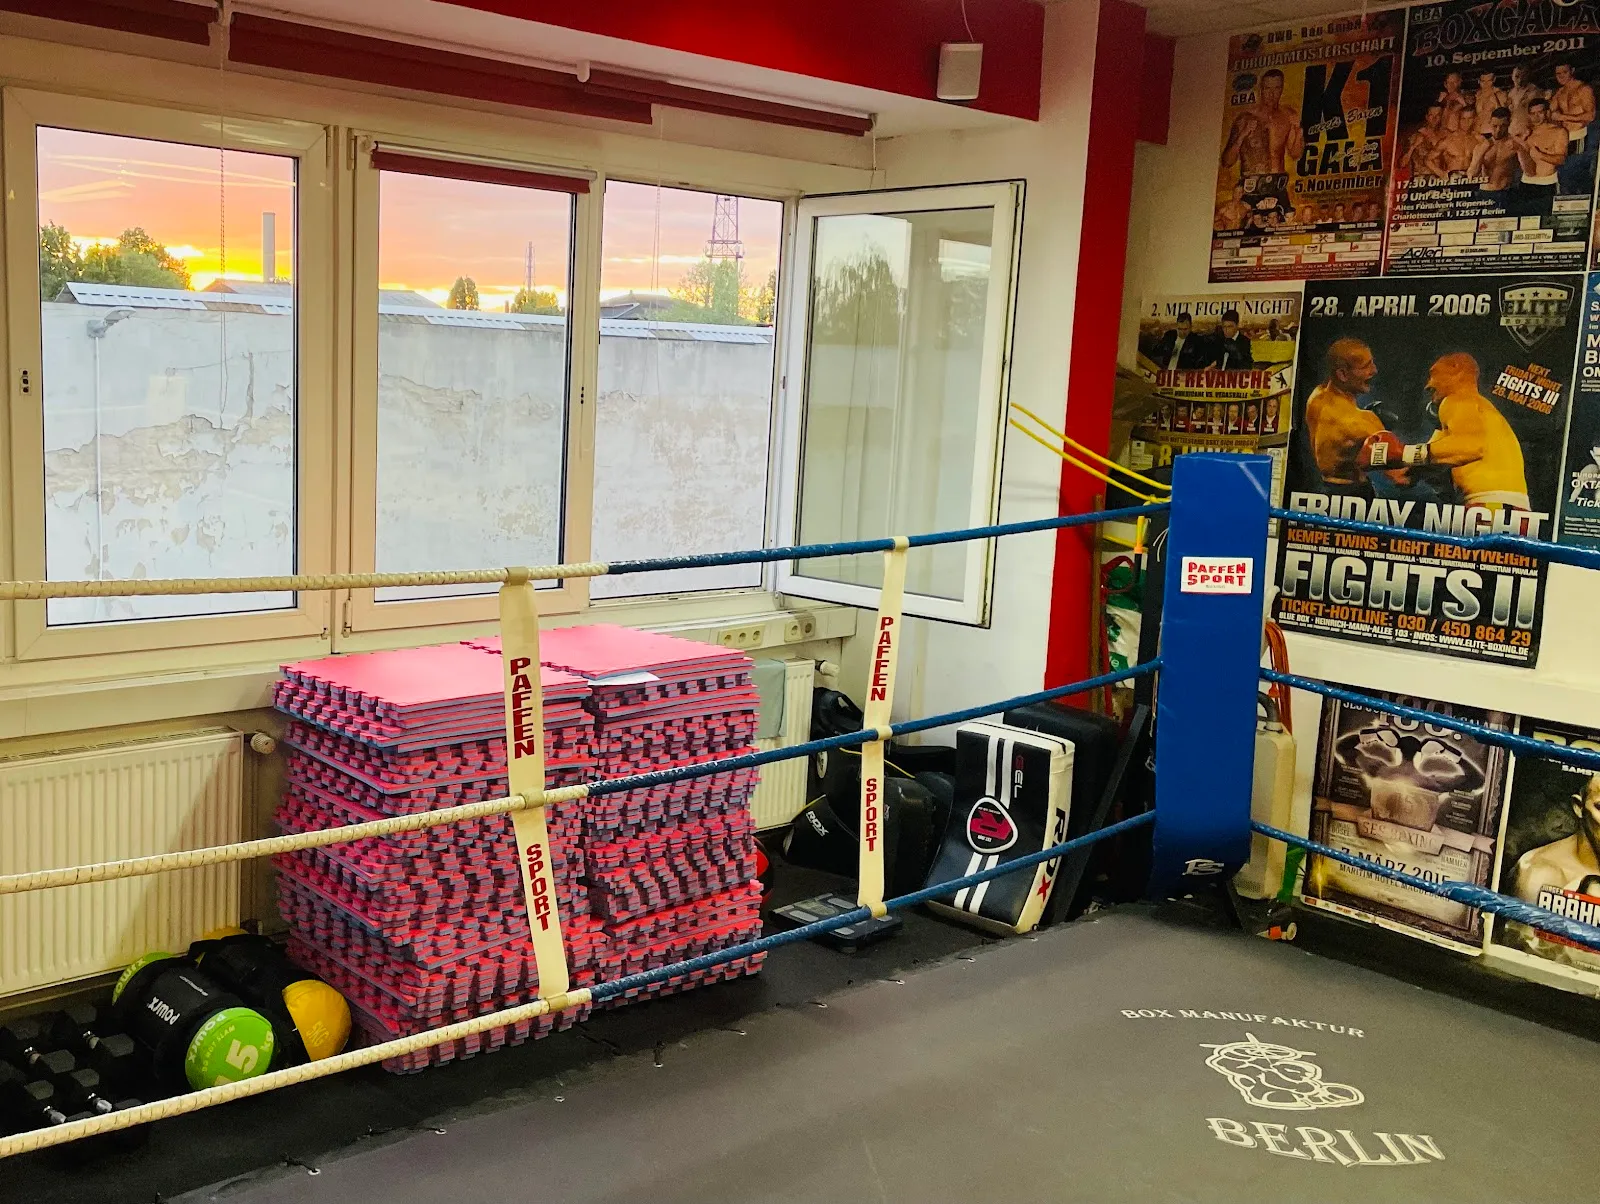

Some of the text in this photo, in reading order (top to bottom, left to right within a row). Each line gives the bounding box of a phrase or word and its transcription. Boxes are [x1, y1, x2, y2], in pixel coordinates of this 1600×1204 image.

[1425, 37, 1586, 68] 10. September 2011
[1301, 54, 1395, 141] K1
[1296, 138, 1384, 177] GALA
[1395, 193, 1409, 203] 19
[1431, 190, 1472, 201] Beginn
[1397, 178, 1427, 189] 17:30
[1427, 176, 1448, 187] Uhr
[1482, 207, 1506, 216] Berlin
[1151, 298, 1295, 317] 2. MIT FIGHT NIGHT
[1309, 293, 1492, 318] 28. APRIL 2006
[1155, 369, 1273, 390] DIE REVANCHE
[1503, 363, 1535, 382] FRIDAY
[1536, 372, 1563, 394] NIGHT
[1527, 361, 1552, 376] NEXT
[1496, 371, 1561, 407] FIGHTS III
[1506, 389, 1527, 406] MAI
[1526, 398, 1554, 416] 2006
[1288, 491, 1416, 528] FRIDAY
[1423, 502, 1549, 541] NIGHT
[1287, 528, 1332, 544] KEMPE
[1334, 534, 1379, 550] TWINS
[1389, 538, 1431, 556] LIGHT
[1432, 543, 1538, 568] HEAVYWEIGHT
[1187, 574, 1246, 587] SPORT
[1188, 561, 1246, 574] PAFFEN
[1281, 549, 1539, 630] FIGHTS II
[1278, 611, 1530, 656] BLUE BOX HEINRICH-MANN-ALLEE 103 INFOS: WWW.ELITE-BOXING.DE
[1279, 597, 1393, 628] TICKET-HOTLINE:
[1397, 613, 1427, 632] 030
[1440, 619, 1471, 638] 450
[1474, 625, 1506, 644] 864
[1509, 630, 1532, 647] 29
[870, 615, 894, 702] PAFFEN
[510, 657, 535, 759] PAFFEN
[805, 810, 830, 837] RDX
[865, 778, 877, 852] SPORT
[1362, 821, 1387, 837] SES
[1339, 863, 1373, 879] MARITIM
[526, 843, 551, 931] SPORT
[216, 1025, 236, 1042] SLAM
[1120, 1009, 1365, 1038] BOX MANUFAKTUR
[1205, 1117, 1446, 1168] BERLIN
